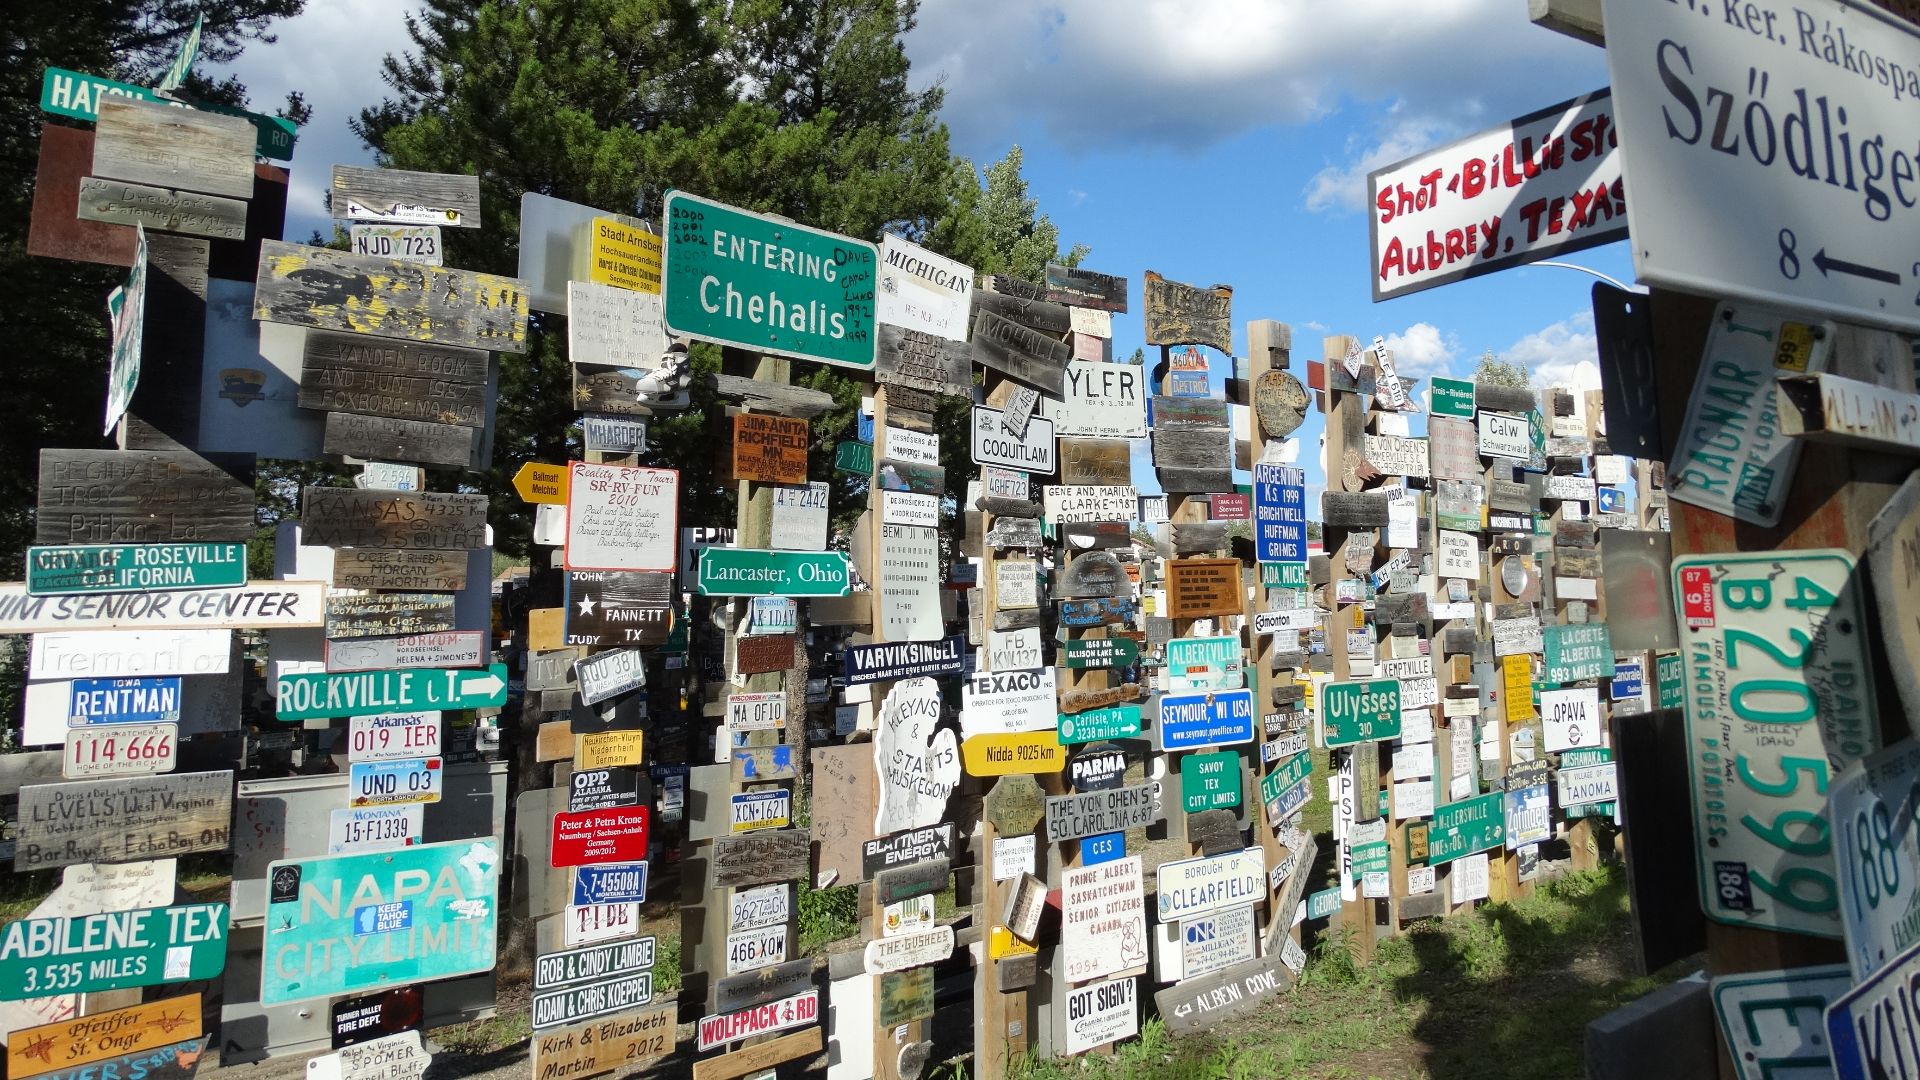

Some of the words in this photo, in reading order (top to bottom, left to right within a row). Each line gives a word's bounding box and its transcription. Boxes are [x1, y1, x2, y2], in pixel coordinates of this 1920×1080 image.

[1792, 8, 1920, 101] Rákospa
[51, 75, 143, 115] HAT
[1657, 38, 1920, 222] Sződlige
[1520, 175, 1626, 243] TEXAS
[358, 237, 390, 255] NJD
[403, 237, 435, 255] 723
[600, 226, 625, 243] Stadt
[627, 233, 663, 256] Arnsberg
[714, 230, 837, 283] ENTERING
[1778, 228, 1801, 281] 8
[884, 249, 970, 294] MICHIGAN
[701, 275, 845, 338] Chehalis
[1490, 418, 1518, 437] Calw
[1681, 360, 1762, 496] RAGNAR
[739, 431, 806, 450] RICHFIELD
[983, 439, 1048, 464] COQUITLAM
[1483, 440, 1527, 454] Schwarzwald
[575, 465, 613, 481] Reality
[620, 469, 641, 480] RV
[647, 471, 673, 483] Tours
[1257, 465, 1304, 486] ARGENTINE
[590, 481, 660, 495] SR-RV-FUN
[1049, 487, 1073, 497] GENE
[1077, 488, 1095, 497] AND
[1100, 487, 1136, 497] MARILYN
[306, 497, 415, 521] KANSAS
[608, 494, 638, 506] 2010
[135, 546, 236, 565] ROSEVILLE
[344, 576, 378, 586] FORT
[382, 576, 428, 587] WORTH
[572, 572, 603, 581] JOHN
[706, 560, 791, 584] Lancaster,
[798, 562, 842, 582] Ohio
[1282, 566, 1305, 583] MICH
[53, 595, 173, 620] SENIOR
[179, 592, 300, 617] CENTER
[606, 610, 664, 621] FANNETT
[1256, 614, 1290, 631] Edmonton
[625, 629, 643, 641] TX
[1577, 628, 1603, 642] CRETE
[854, 641, 958, 669] VARVIKSINGEL
[1561, 646, 1601, 662] ALBERTA
[1384, 660, 1428, 678] KEMPTVILLE
[1551, 667, 1568, 681] 993
[1573, 664, 1600, 679] MILES
[1692, 641, 1716, 720] FAMOUS
[112, 679, 141, 687] IOWA
[277, 673, 414, 712] ROCKVILLE
[968, 673, 1040, 695] TEXACO
[75, 687, 175, 716] RENTMAN
[1163, 703, 1211, 725] SEYMOUR,
[1216, 702, 1227, 719] WI
[1233, 700, 1250, 717] USA
[1331, 690, 1396, 722] Ulysses
[1554, 702, 1585, 723] OPAVA
[371, 715, 422, 728] Arkansas
[888, 698, 938, 732] KLEYNS
[1075, 713, 1109, 726] Carlisle,
[1112, 711, 1122, 722] PA
[354, 729, 389, 752] 019
[404, 725, 436, 747] IER
[585, 733, 640, 746] Neukirchen-Vluyn
[1077, 727, 1096, 738] 3238
[1097, 726, 1119, 737] miles
[1743, 723, 1801, 736] SHELLEY
[986, 746, 1013, 762] Nidda
[1018, 745, 1039, 760] 9025
[1040, 746, 1054, 759] km
[1562, 752, 1601, 767] MISHAWAKA
[1072, 755, 1126, 778] PARMA
[1200, 761, 1223, 774] SAVOY
[363, 773, 396, 795] UND
[409, 771, 431, 790] 03
[574, 771, 609, 788] OPP
[1205, 779, 1219, 790] TEX
[1567, 782, 1611, 800] TANOMA
[1701, 737, 1727, 838] POTATOES
[34, 797, 119, 822] LEVELS,
[123, 794, 156, 813] West
[162, 792, 215, 811] Virginia
[1189, 796, 1206, 807] CITY
[1213, 792, 1235, 804] LIMITS
[354, 810, 401, 820] MONTANA
[560, 820, 583, 830] Peter
[585, 819, 592, 828] &
[595, 817, 615, 827] Petra
[618, 815, 642, 824] Krone
[1051, 819, 1071, 839] SO.
[1074, 811, 1130, 835] CAROLINA
[1133, 807, 1152, 824] 6-87
[584, 847, 616, 857] 2009/2012
[866, 830, 934, 855] BLATTNER
[885, 841, 941, 864] ENERGY
[1093, 840, 1112, 855] CES
[1070, 871, 1096, 887] PRINCE
[1105, 863, 1136, 879] ALBERT,
[1185, 862, 1223, 879] BOROUGH
[1231, 859, 1240, 870] OF
[302, 865, 465, 924] NAPA
[1071, 880, 1135, 904] SASKATCHEWAN
[1173, 876, 1256, 911] CLEARFIELD,
[377, 911, 408, 922] TAHOE
[378, 903, 402, 913] KEEP
[577, 904, 628, 932] TIDE
[1, 910, 155, 960] ABILENE,
[166, 905, 222, 944] TEX
[377, 920, 402, 930] BLUE
[276, 936, 364, 979] CITY
[384, 921, 480, 962] LIMIT
[905, 930, 949, 949] GUSHEES
[23, 963, 83, 992] 3,535
[89, 956, 148, 980] MILES
[540, 958, 564, 984] ROB
[567, 956, 575, 978] &
[579, 949, 613, 975] CINDY
[614, 942, 651, 969] LAMBIE
[537, 994, 565, 1024] ADAM
[568, 993, 575, 1017] &
[578, 986, 606, 1014] CHRIS
[608, 977, 648, 1005] KOEPPEL
[1197, 983, 1242, 1013] ALBENI
[1246, 969, 1281, 995] COVE
[1070, 991, 1092, 1020] GOT
[69, 1010, 143, 1039] Pfeiffer
[338, 1021, 357, 1034] FIRE
[359, 1014, 381, 1027] DEPT.
[702, 1003, 779, 1045] WOLFPACK
[796, 997, 816, 1020] RD
[542, 1034, 573, 1055] Kirk
[580, 1028, 592, 1045] &
[600, 1011, 666, 1041] Elizabeth
[67, 1041, 91, 1061] St.
[98, 1031, 142, 1054] Onge
[542, 1056, 595, 1080] Martin
[626, 1035, 664, 1059] 2012
